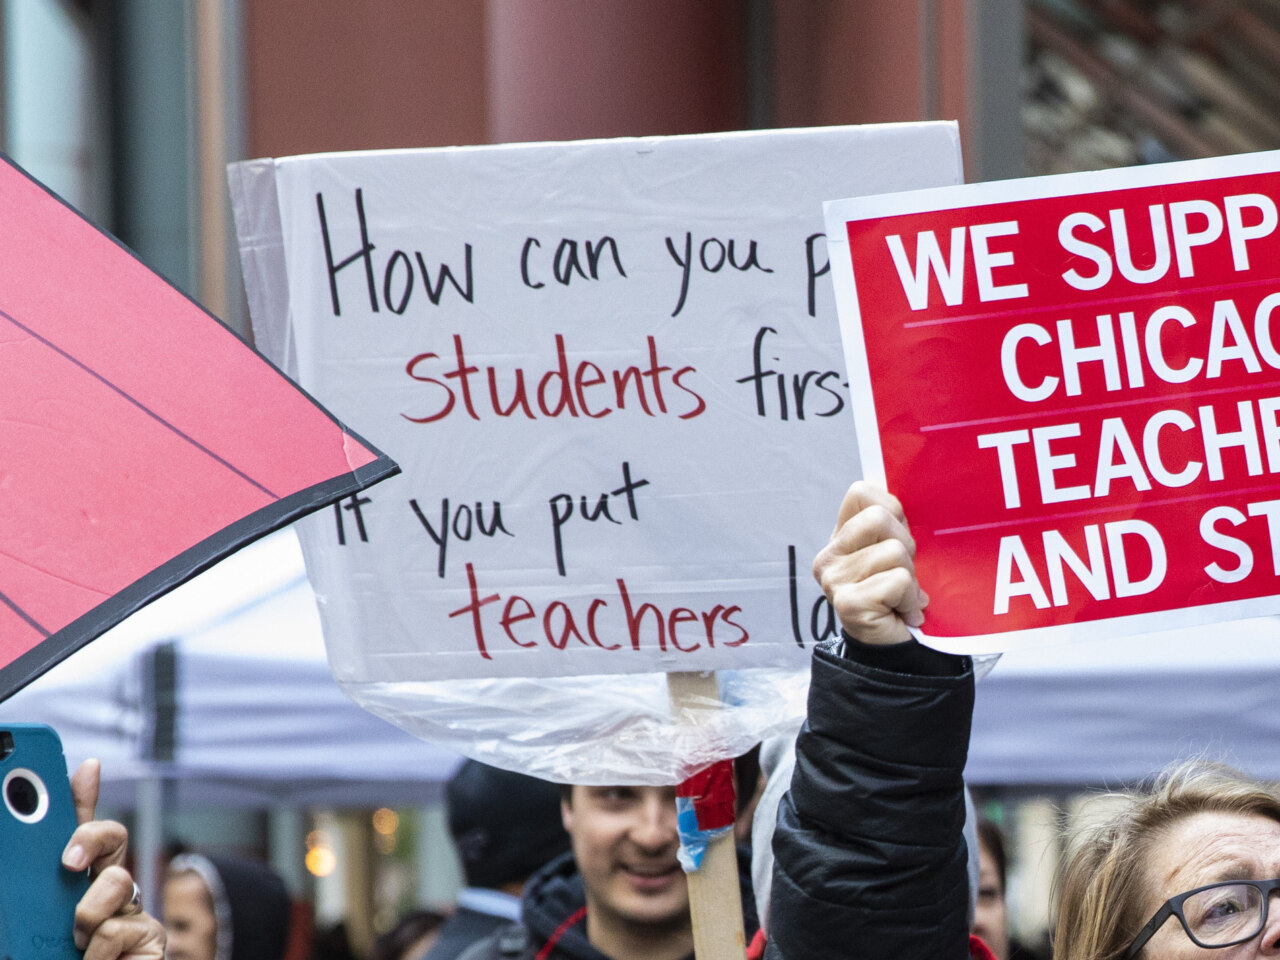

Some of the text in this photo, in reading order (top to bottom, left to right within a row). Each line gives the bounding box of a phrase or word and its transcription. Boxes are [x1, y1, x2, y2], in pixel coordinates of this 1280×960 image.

[316, 188, 474, 316] How
[521, 235, 628, 290] can
[665, 231, 774, 318] you
[885, 221, 1029, 312] WE
[736, 327, 849, 421] firs
[409, 497, 515, 579] you
[549, 461, 650, 578] put
[993, 519, 1167, 616] AND
[448, 562, 750, 660] teachers
